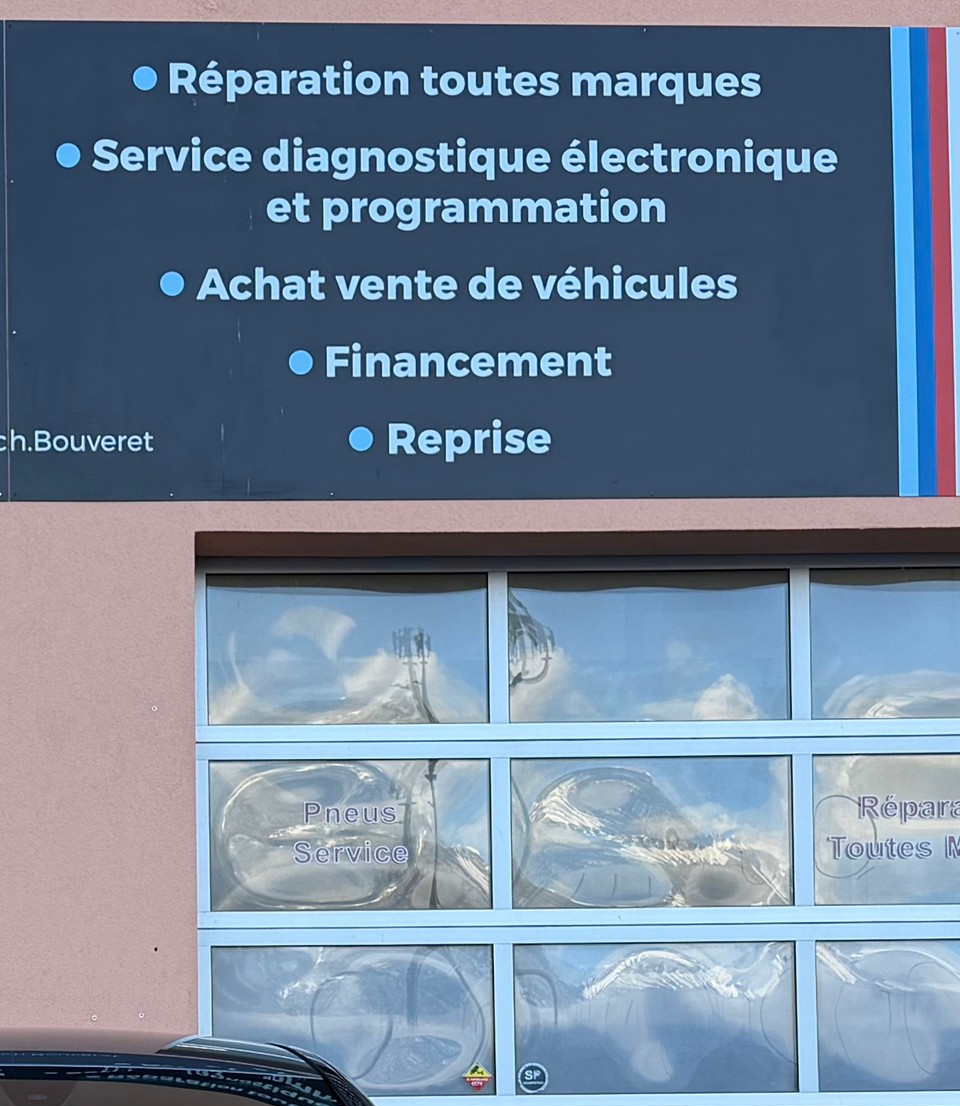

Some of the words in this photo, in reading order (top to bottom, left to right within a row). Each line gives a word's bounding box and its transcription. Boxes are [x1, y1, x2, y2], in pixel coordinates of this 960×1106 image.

[169, 61, 409, 102] Réparation
[421, 66, 559, 97] toutes
[572, 71, 761, 104] marques
[93, 137, 251, 172] Service
[263, 137, 550, 180] diagnostique
[562, 138, 837, 180] électronique
[267, 193, 310, 223] et
[323, 190, 666, 231] programmation
[197, 267, 325, 301] Achat
[336, 271, 457, 301] vente
[469, 267, 522, 301] de
[534, 265, 738, 301] véhicules
[326, 343, 612, 378] Financement
[388, 424, 552, 462] Reprise
[303, 801, 398, 824] Pneus
[293, 840, 409, 863] Service
[826, 835, 933, 860] Toutes
